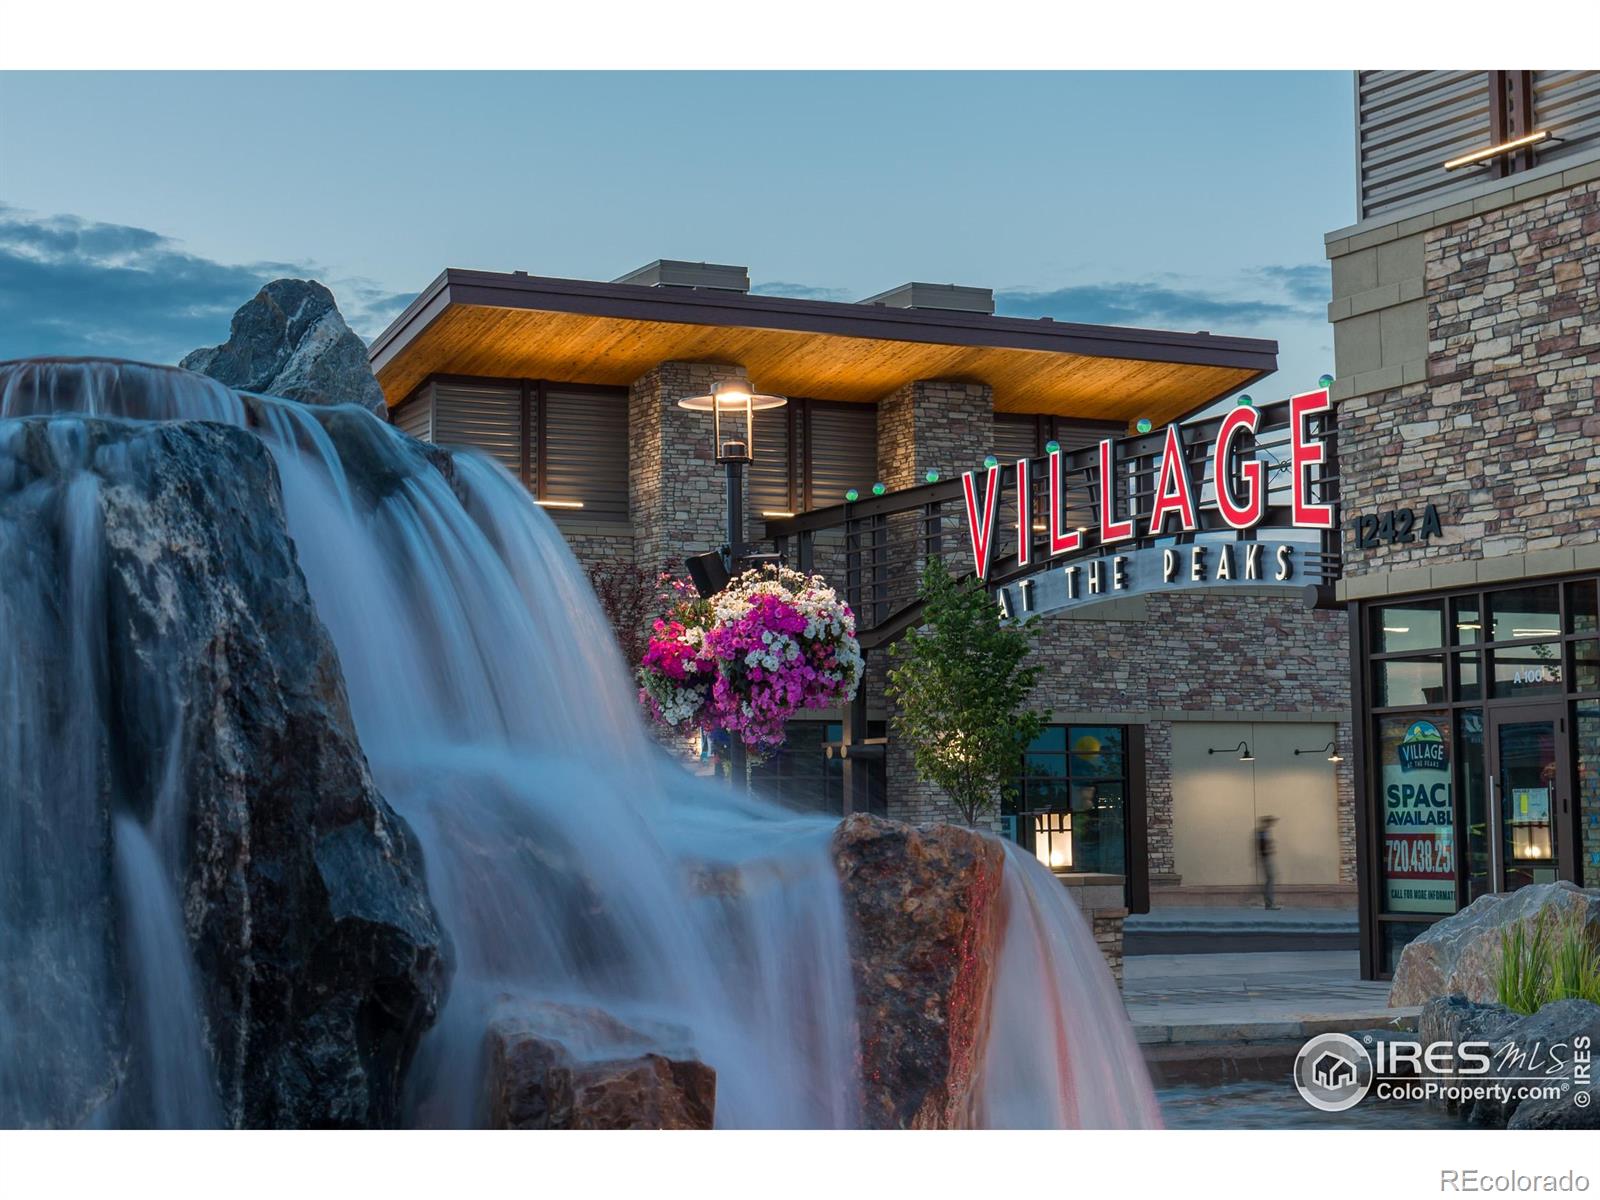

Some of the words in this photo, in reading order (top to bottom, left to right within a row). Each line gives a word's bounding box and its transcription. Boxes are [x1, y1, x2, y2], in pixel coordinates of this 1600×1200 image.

[962, 387, 1333, 580] VILLAGE
[1352, 508, 1415, 549] 1242
[1421, 504, 1443, 539] A
[997, 579, 1034, 619] AT
[1065, 556, 1128, 599] THE
[1163, 544, 1293, 584] PEAKS
[1513, 671, 1521, 684] A
[1524, 669, 1543, 683] 100
[1402, 743, 1444, 760] VILLAGE
[1391, 889, 1403, 899] CALL
[1404, 889, 1413, 899] FOR
[1414, 889, 1427, 900] MORE
